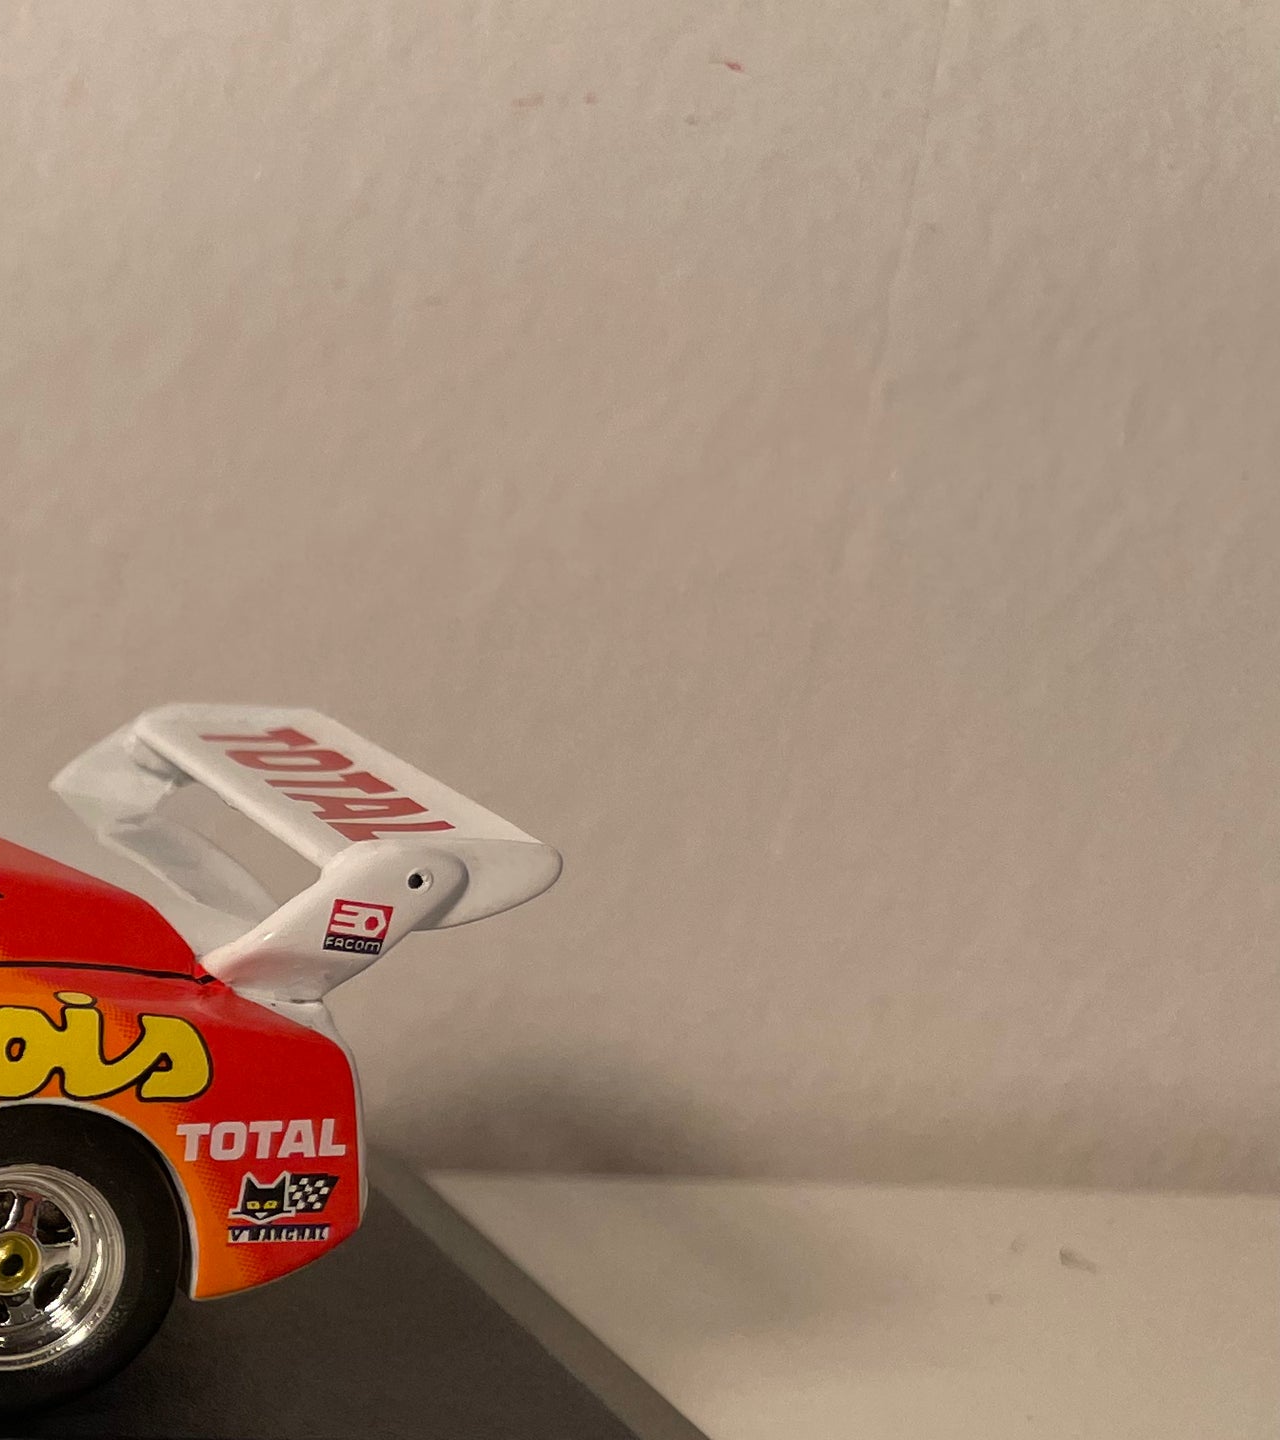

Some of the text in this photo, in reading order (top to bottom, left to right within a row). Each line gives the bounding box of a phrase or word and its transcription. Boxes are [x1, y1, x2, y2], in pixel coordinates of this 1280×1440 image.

[198, 727, 456, 842] TOTAL
[325, 937, 381, 952] FACOM
[176, 1118, 347, 1162] TOTAL
